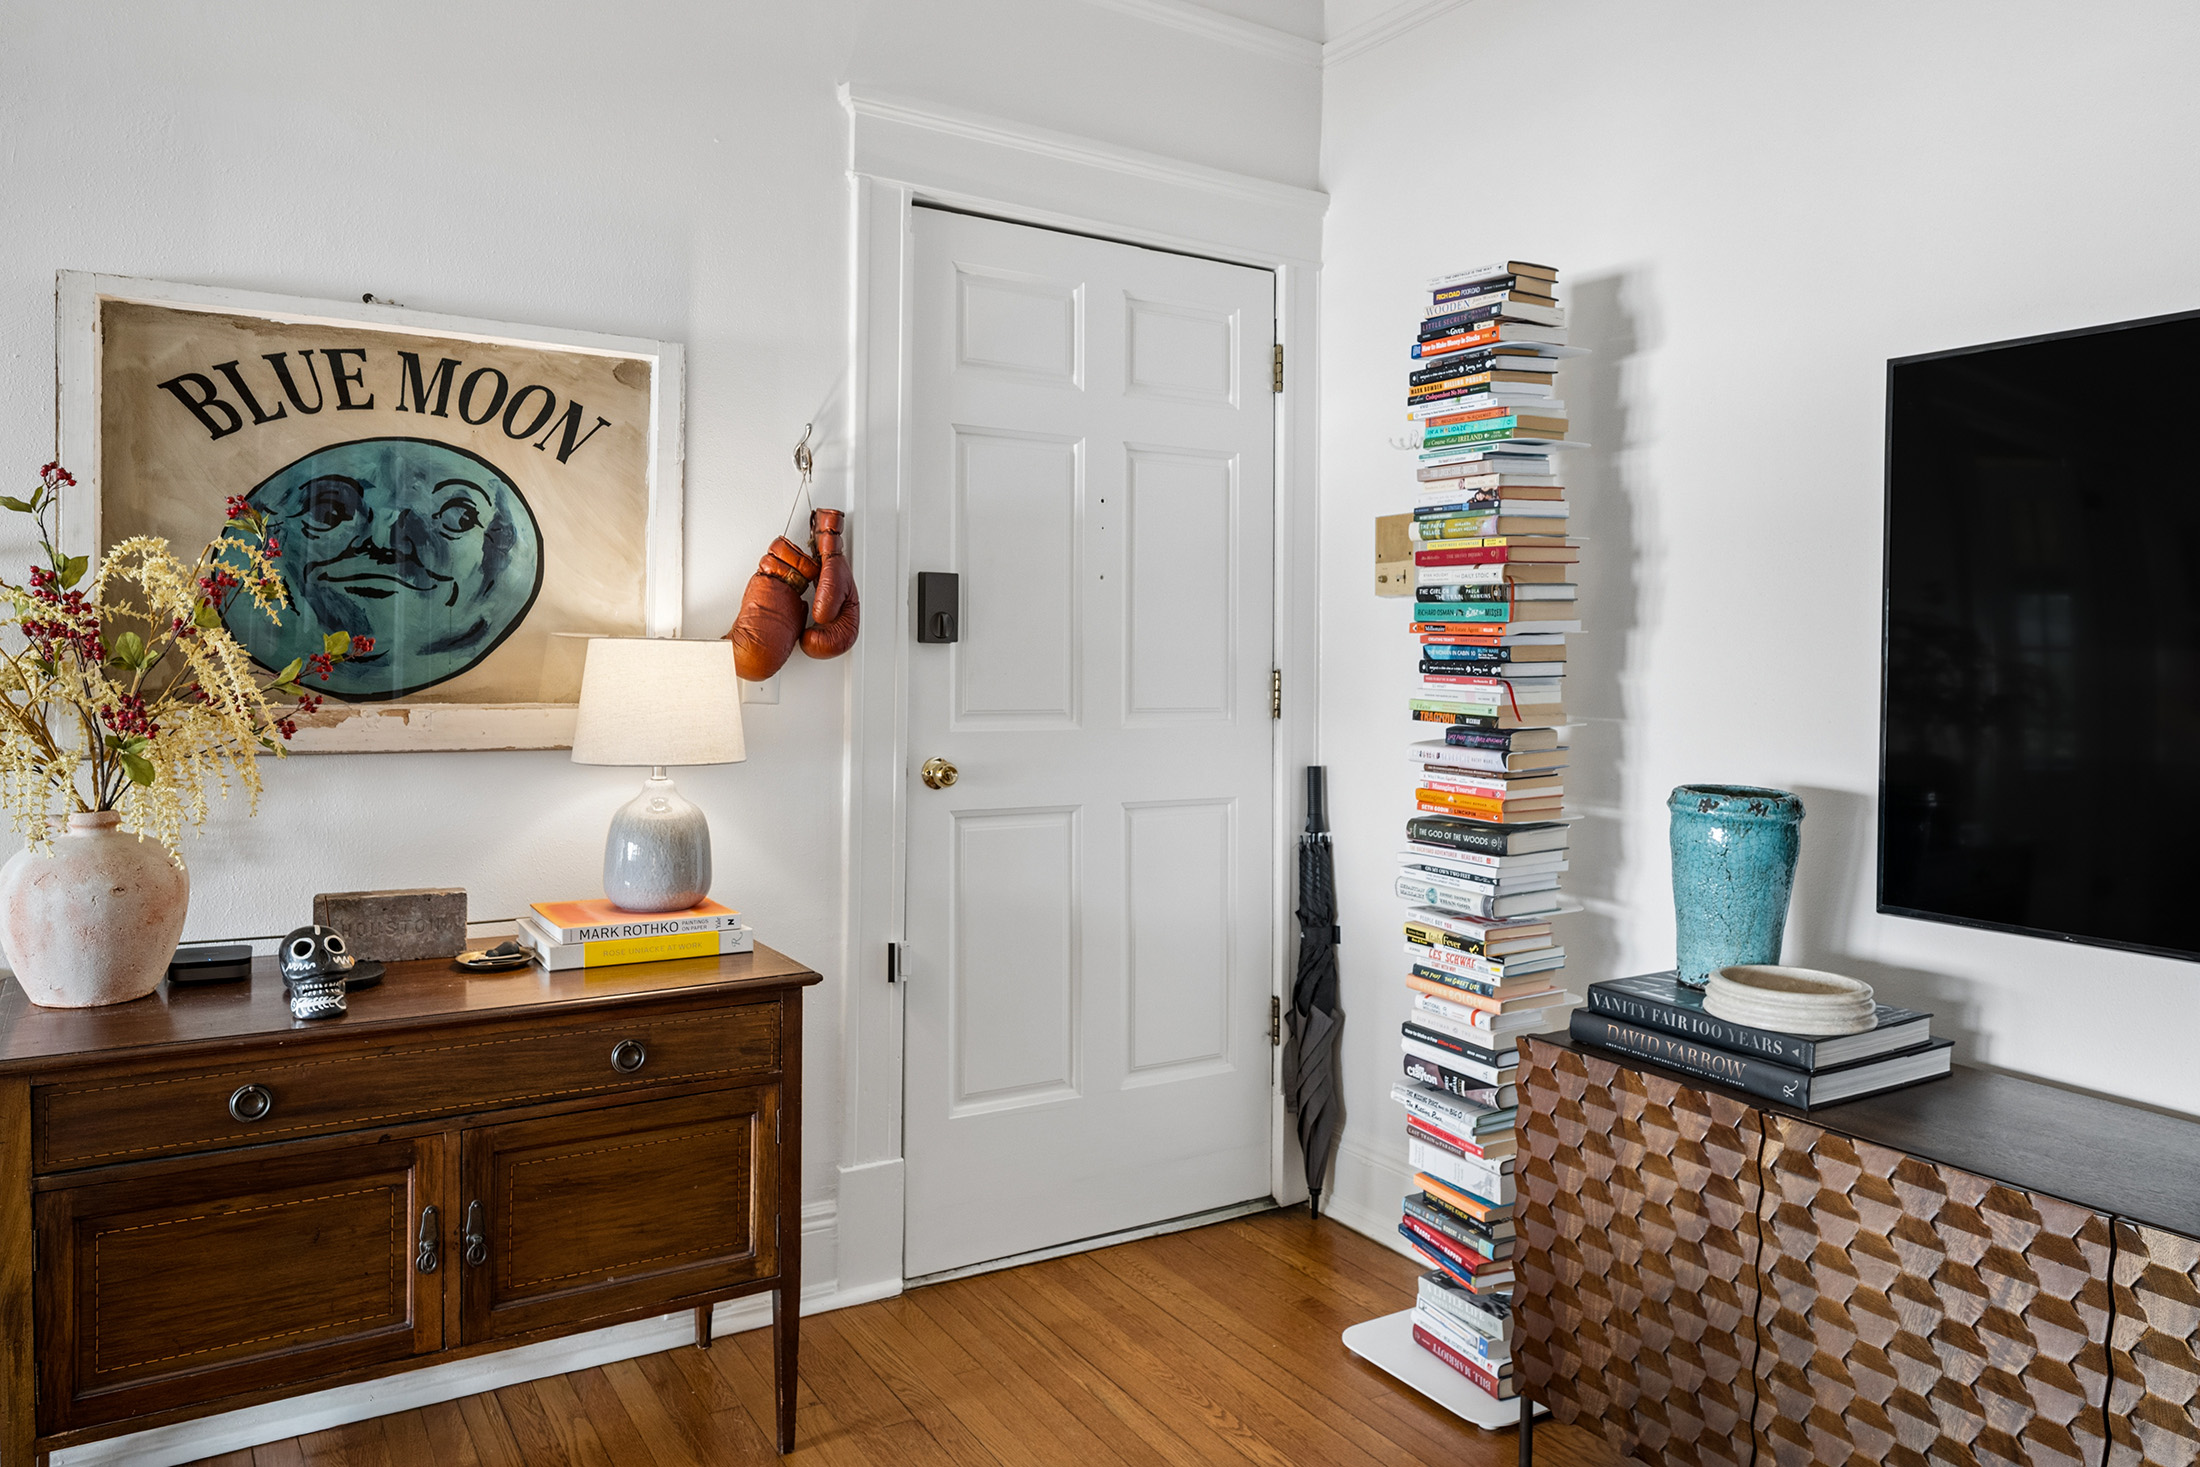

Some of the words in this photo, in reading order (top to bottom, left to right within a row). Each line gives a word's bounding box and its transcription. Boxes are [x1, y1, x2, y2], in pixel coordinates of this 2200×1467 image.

[1436, 293, 1449, 301] RICH
[1449, 290, 1460, 298] DAD
[1425, 300, 1470, 316] WOODEN
[1422, 320, 1442, 332] LITTLE
[1443, 314, 1468, 325] SECRETS
[1422, 344, 1430, 352] How
[1447, 338, 1460, 347] Money
[1466, 334, 1480, 342] Stocks
[1424, 384, 1442, 393] BOWDEN
[1465, 375, 1482, 384] PABLO
[1426, 390, 1451, 401] Codependent
[1456, 388, 1468, 396] More
[158, 347, 376, 442] BLUE
[395, 350, 613, 465] MOON
[1432, 438, 1446, 446] Course
[1458, 432, 1483, 442] IRELAND
[1484, 608, 1502, 618] MISSED
[1420, 711, 1456, 724] TRACTION
[1432, 782, 1456, 792] Managing
[1456, 786, 1477, 794] Yourself
[1419, 828, 1427, 836] THE
[1428, 830, 1443, 838] GOD
[1444, 832, 1452, 840] OF
[1452, 833, 1462, 842] THE
[1462, 834, 1488, 846] WOODS
[1438, 868, 1450, 876] OWN
[1450, 870, 1460, 878] TWO
[1440, 898, 1456, 906] THAN
[341, 918, 441, 938] HOUSTON
[580, 926, 620, 941] MARK
[623, 921, 679, 937] ROTHKO
[1444, 922, 1452, 930] YOU
[628, 946, 665, 954] UNIACKE
[679, 942, 703, 950] WORK
[1444, 936, 1462, 949] Fever
[1428, 948, 1442, 960] LES
[1429, 972, 1442, 980] FOLEY
[1452, 978, 1469, 988] GUEST
[1469, 982, 1480, 991] LIST
[1592, 992, 1648, 1019] VANITY
[1652, 1008, 1689, 1032] FAIR
[1692, 1018, 1723, 1039] 100
[1728, 1027, 1783, 1056] YEARS
[1416, 1032, 1427, 1040] Make
[1607, 1024, 1660, 1053] DAVID
[1665, 1040, 1748, 1080] YARROW
[1407, 1066, 1438, 1085] Clayton
[1632, 1050, 1649, 1058] AFRICA
[1653, 1056, 1681, 1068] ANTARCTICA
[1686, 1066, 1704, 1074] ARCTIC
[1708, 1072, 1720, 1080] ASIA
[1726, 1078, 1746, 1087] EUROPE
[1414, 1092, 1428, 1104] MISSING
[1428, 1098, 1438, 1108] PIECE
[1408, 1128, 1420, 1137] LAST
[1420, 1133, 1436, 1144] TRAIN
[1440, 1142, 1462, 1155] PARADISE
[1444, 1202, 1455, 1213] WIFE
[1455, 1208, 1468, 1220] KNEW
[1413, 1224, 1431, 1242] TRADES
[1444, 1246, 1462, 1264] HAPPEN
[1443, 1225, 1458, 1237] ROBERT
[1462, 1236, 1478, 1248] SHILLER
[1427, 1284, 1432, 1292] A
[1434, 1286, 1464, 1311] LITTLE
[1465, 1302, 1484, 1322] LIFE
[1432, 1343, 1472, 1378] MARRIOTT
[1473, 1371, 1492, 1391] BILL
